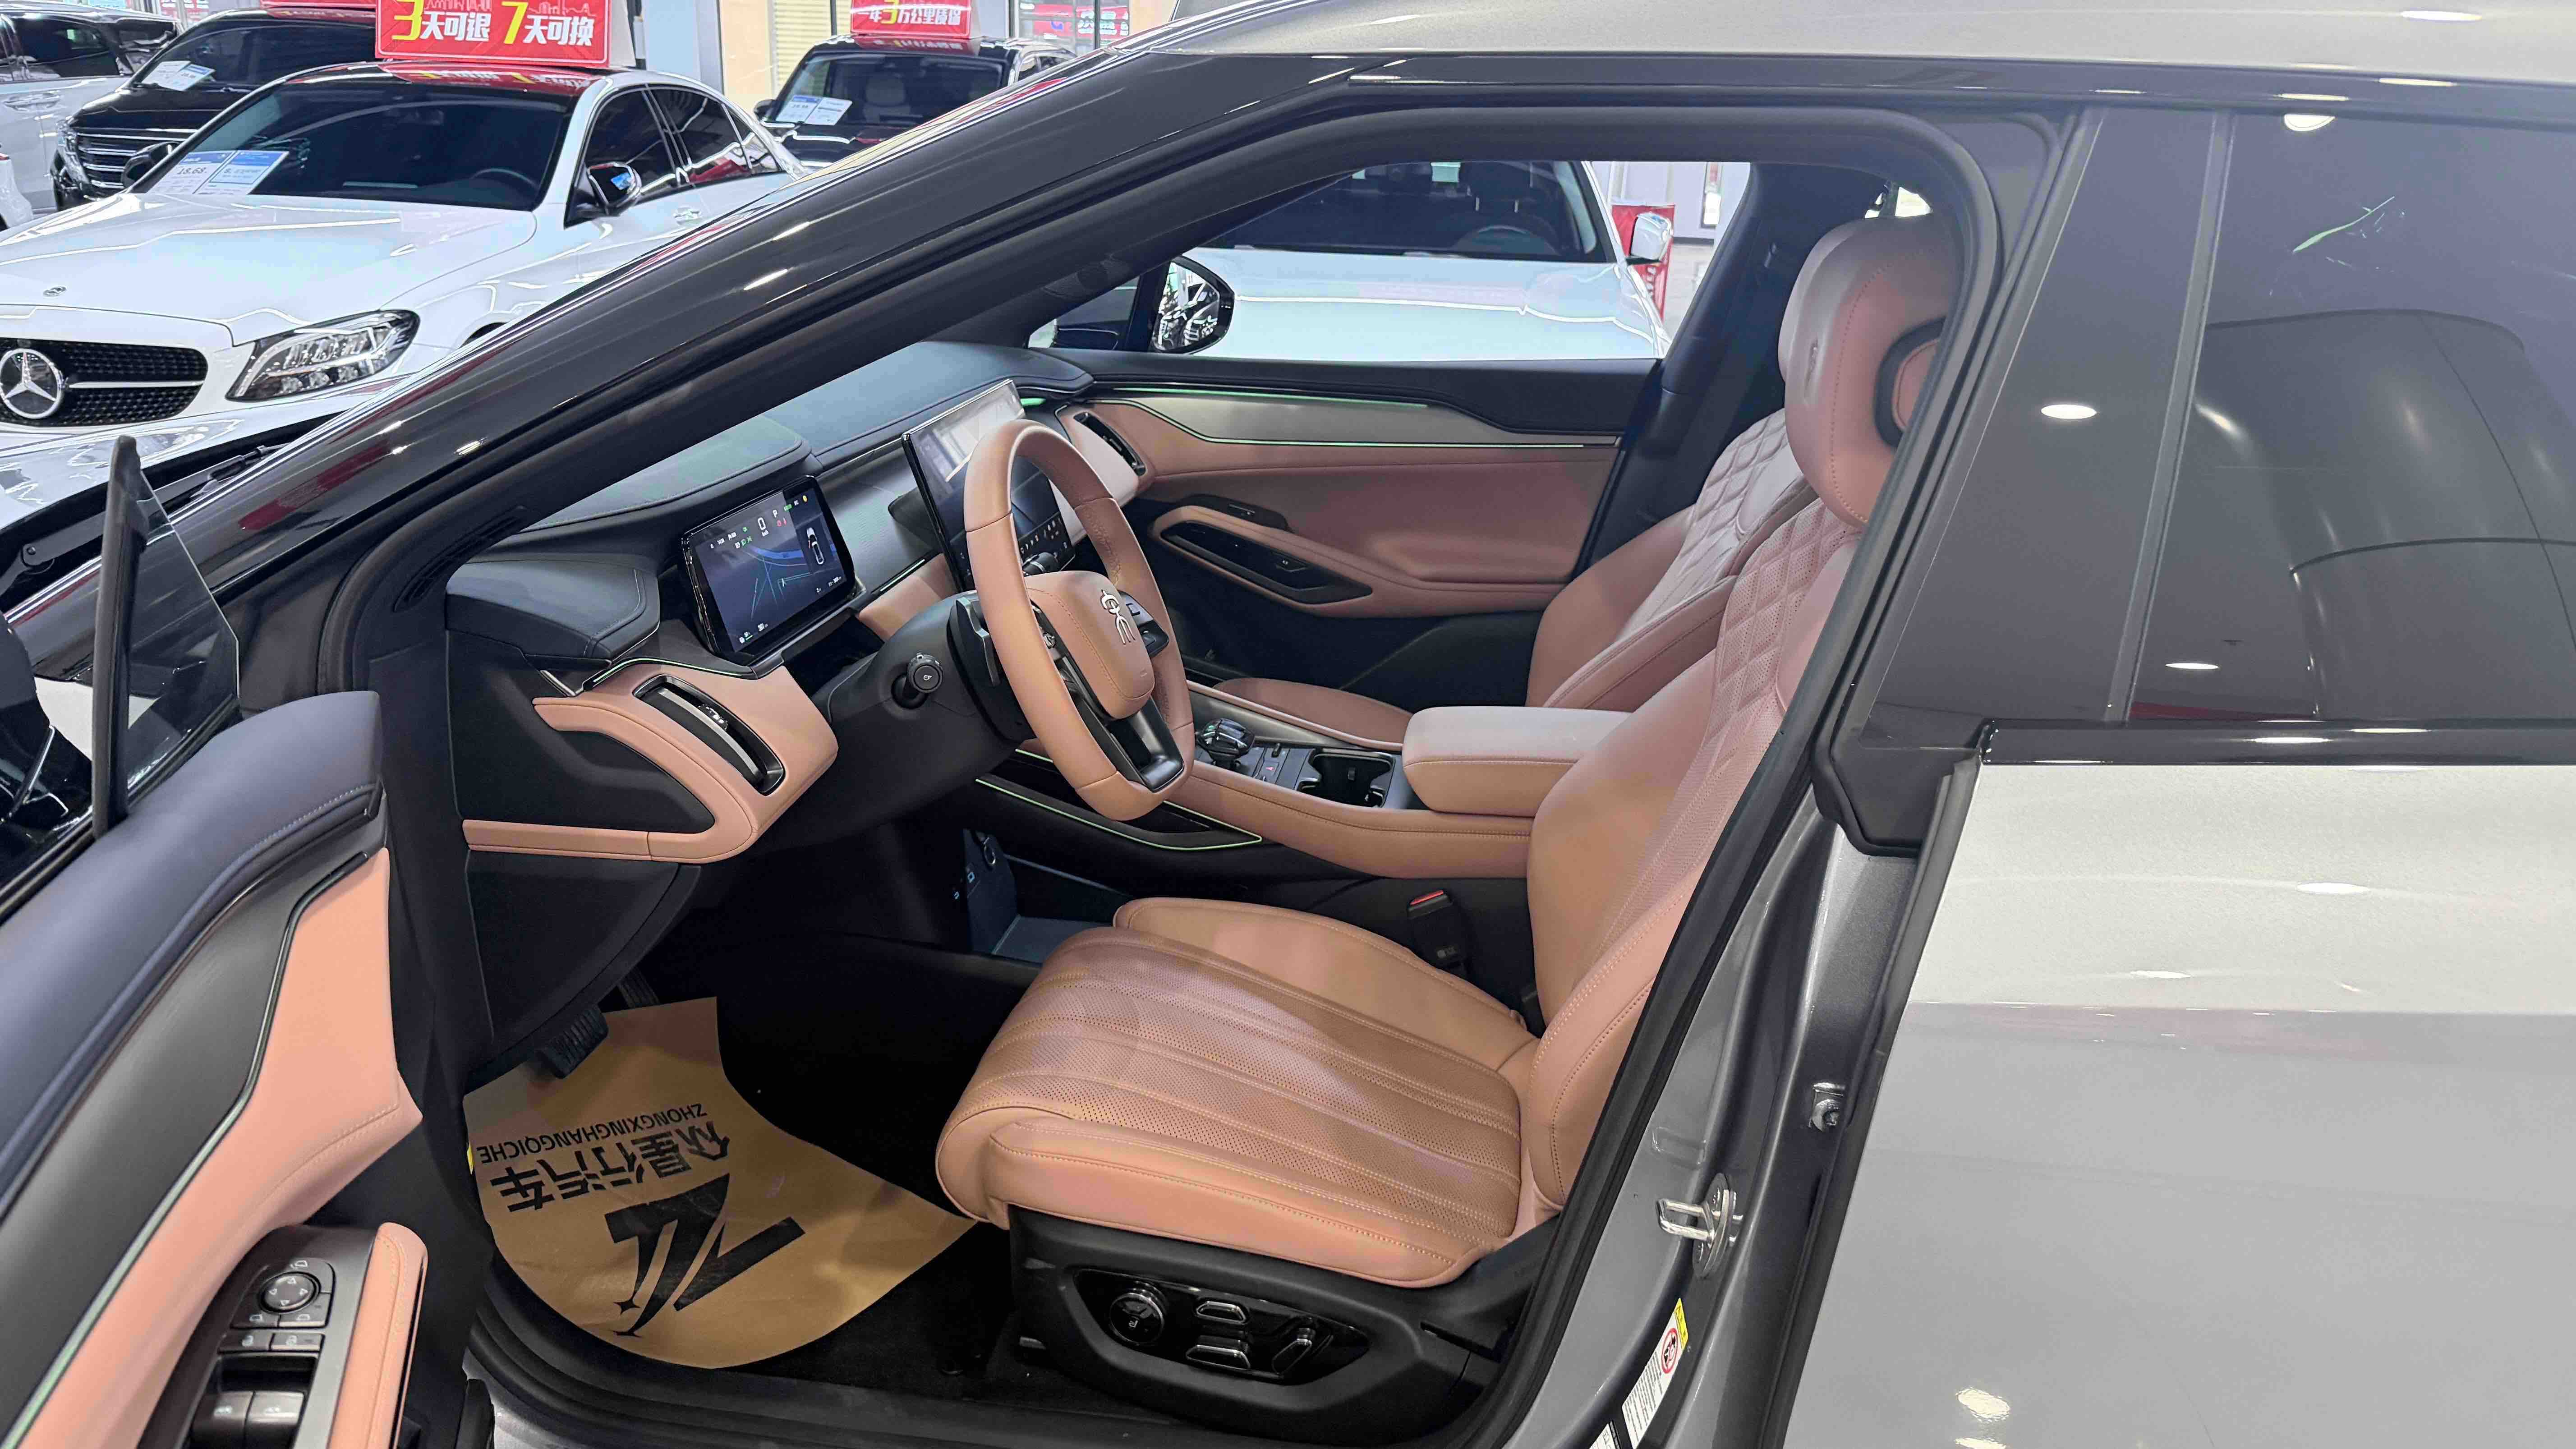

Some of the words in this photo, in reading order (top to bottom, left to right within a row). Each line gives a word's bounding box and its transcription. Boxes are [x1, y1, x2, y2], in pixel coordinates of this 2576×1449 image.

[391, 0, 492, 41] 3天可退
[501, 2, 595, 46] 7天可换
[477, 1104, 707, 1164] ZHONGXINGHANGQICHE
[490, 1121, 730, 1212] 众星行汽车
